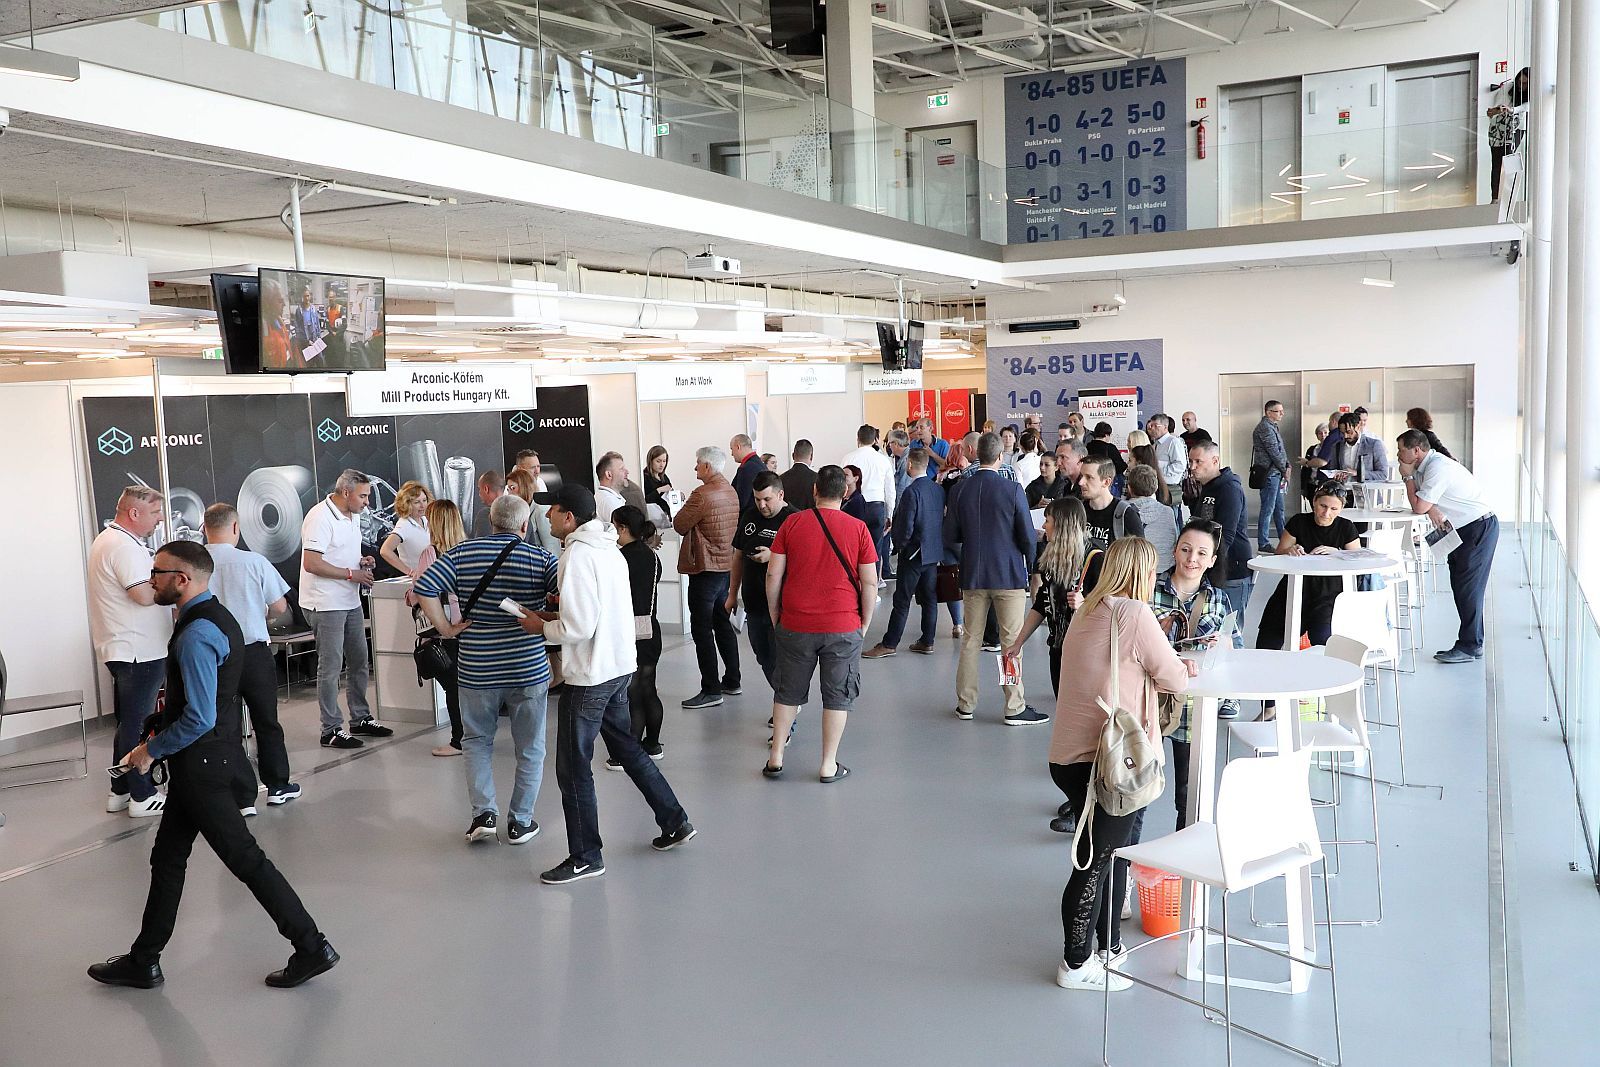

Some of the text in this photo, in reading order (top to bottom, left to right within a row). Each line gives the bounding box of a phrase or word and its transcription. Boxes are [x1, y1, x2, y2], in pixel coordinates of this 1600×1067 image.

[1102, 65, 1167, 91] UEFA
[1076, 107, 1113, 130] 4-2
[1127, 100, 1165, 124] 5-0
[1025, 113, 1060, 136] 1-0
[1137, 126, 1166, 134] Partizan
[1043, 137, 1062, 145] Praha
[1127, 137, 1166, 159] 0-2
[1025, 149, 1061, 170] 0-0
[1077, 143, 1114, 165] 1-0
[1026, 185, 1061, 204] 1-0
[1077, 179, 1112, 201] 3-1
[1127, 175, 1166, 197] 0-3
[1026, 207, 1062, 216] Manchester
[1128, 201, 1167, 211] Real Madrid
[1026, 215, 1055, 224] United Fc
[1078, 219, 1115, 239] 1-2
[1129, 214, 1166, 235] 1-0
[1026, 224, 1060, 243] 0-1
[1081, 352, 1145, 373] UEFA
[411, 371, 484, 384] Arconic-Köfém
[675, 376, 713, 386] Man At Work
[381, 388, 510, 404] Mill Products Hungary Kft.
[1007, 389, 1042, 409] 1-0
[1056, 388, 1078, 408] 4-
[345, 424, 389, 437] ARCONIC
[538, 417, 586, 429] ARCONIC
